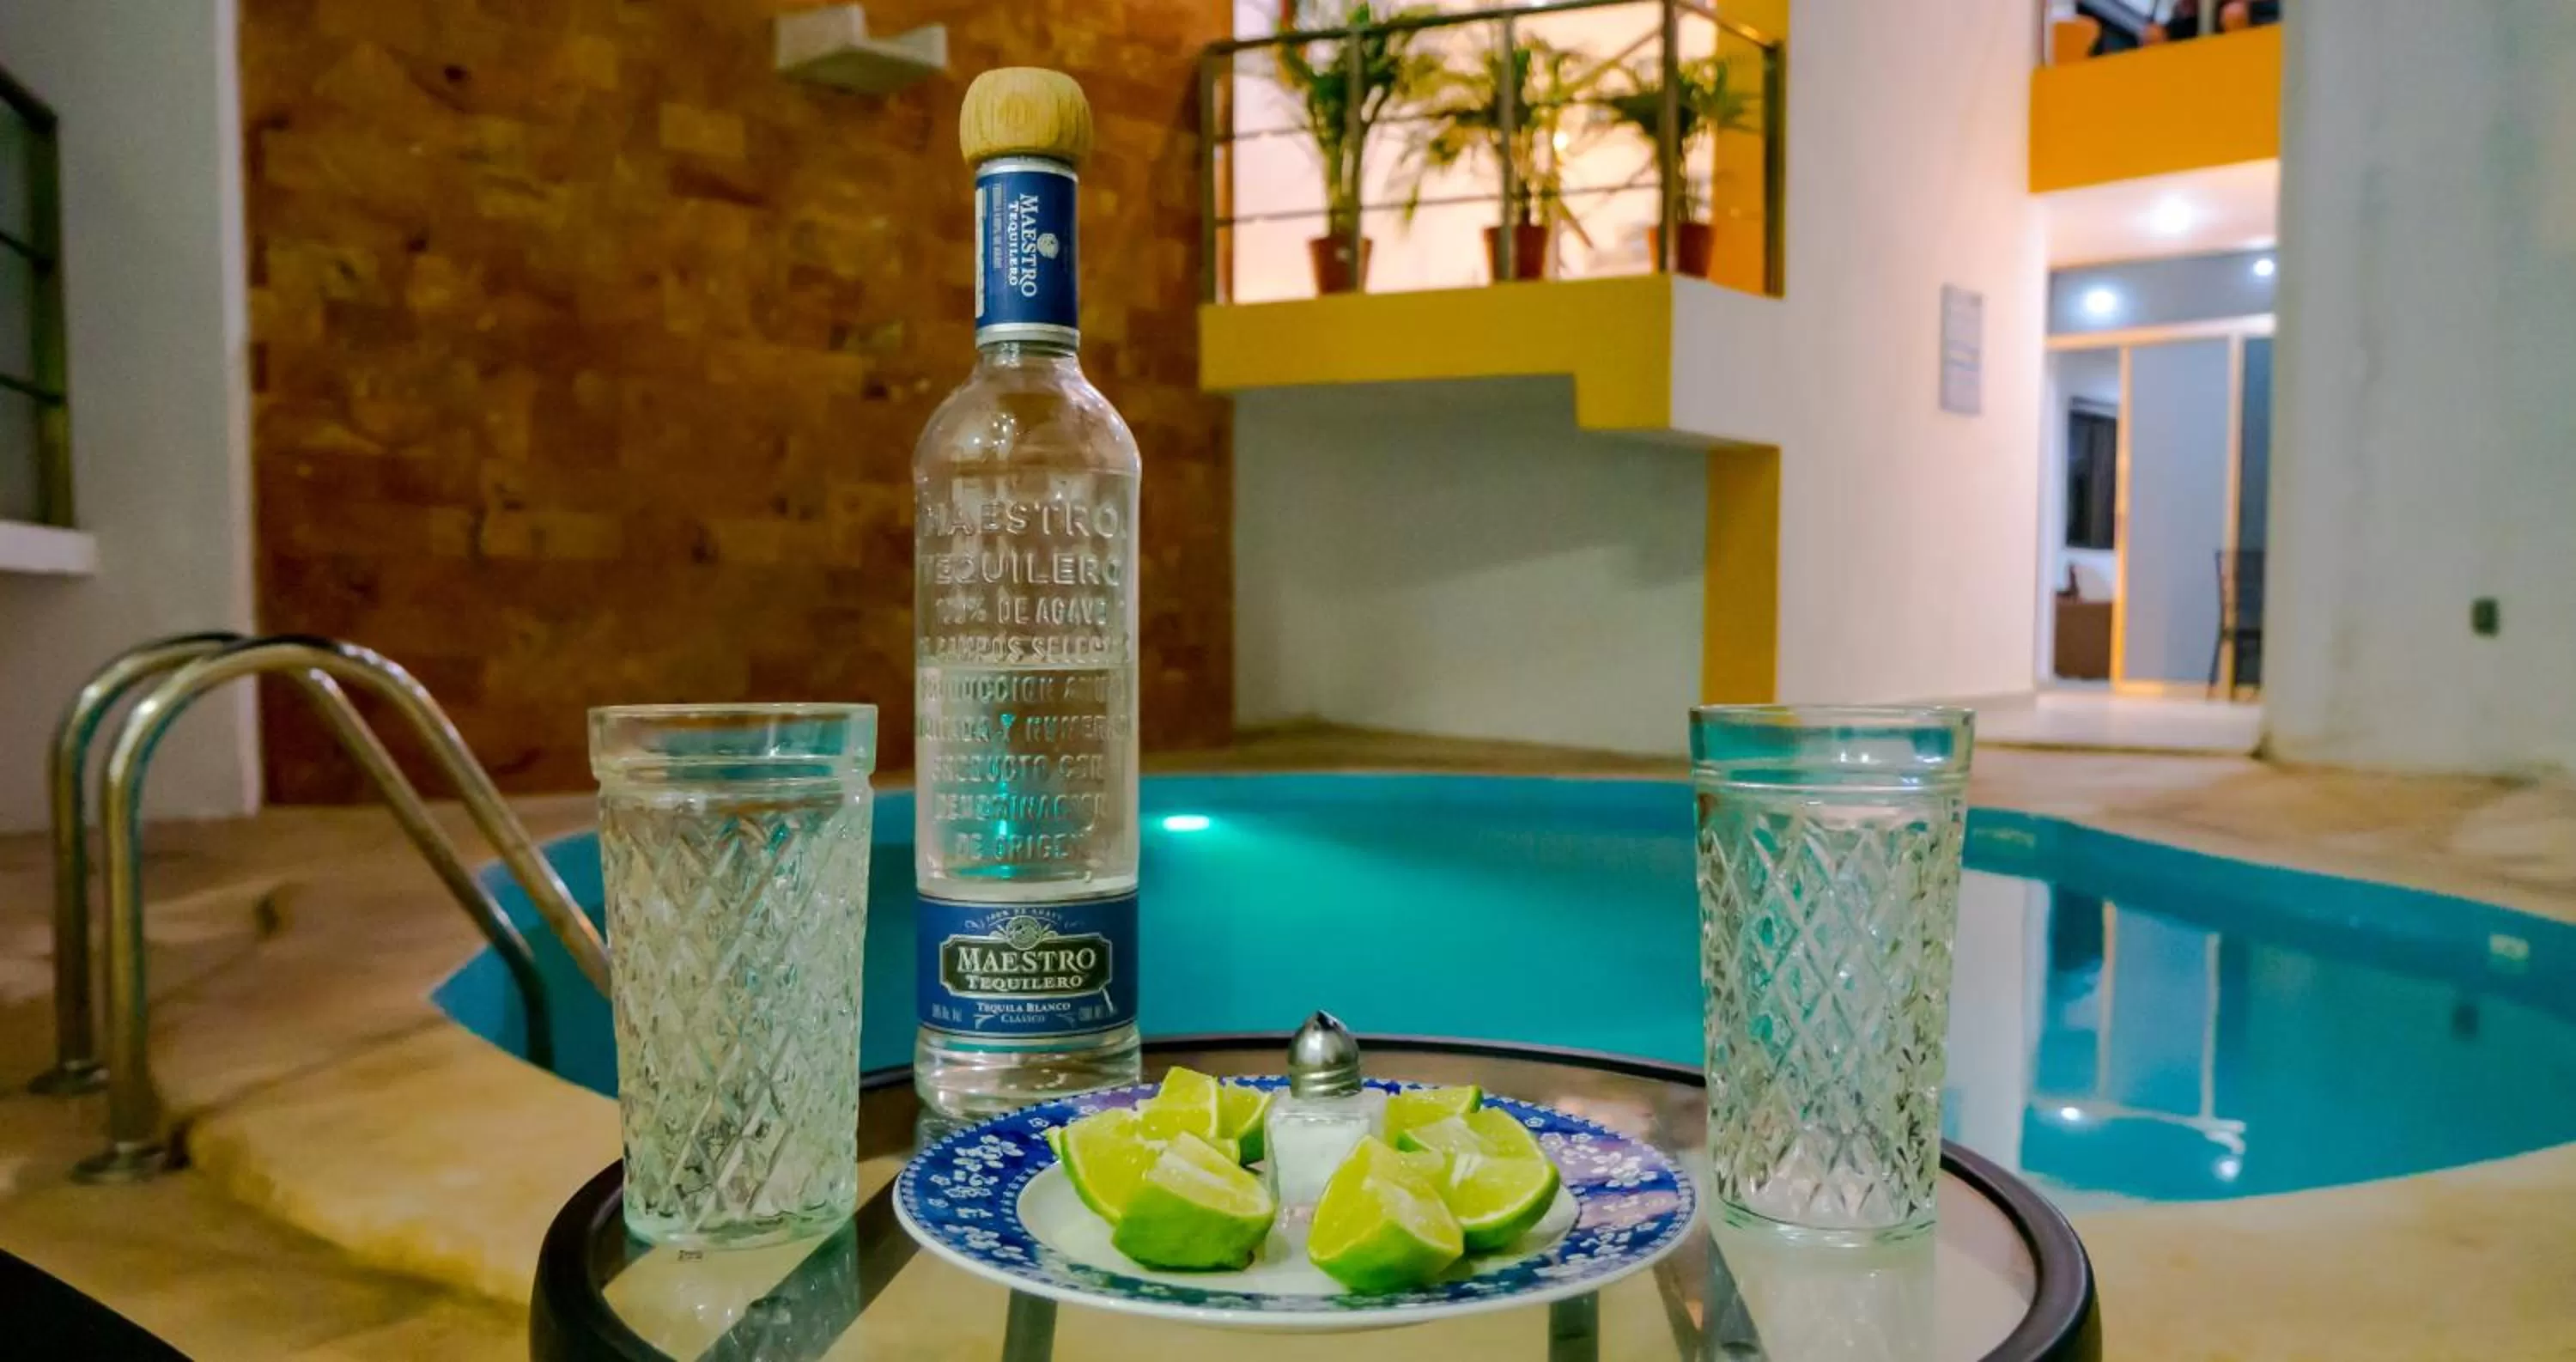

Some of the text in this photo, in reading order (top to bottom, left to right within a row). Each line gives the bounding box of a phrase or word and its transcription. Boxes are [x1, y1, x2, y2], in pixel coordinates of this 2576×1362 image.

[1008, 200, 1019, 286] TEQUILERO
[1019, 192, 1039, 298] MAESTRO
[920, 500, 1119, 539] MAESTRO
[998, 597, 1030, 625] DE
[1035, 596, 1108, 625] AGAVE
[957, 946, 1097, 974] MAESTRO
[965, 974, 1084, 992] TEQUILERO
[975, 1001, 1024, 1015] TEQUILA
[1026, 1001, 1071, 1012] BLANCO
